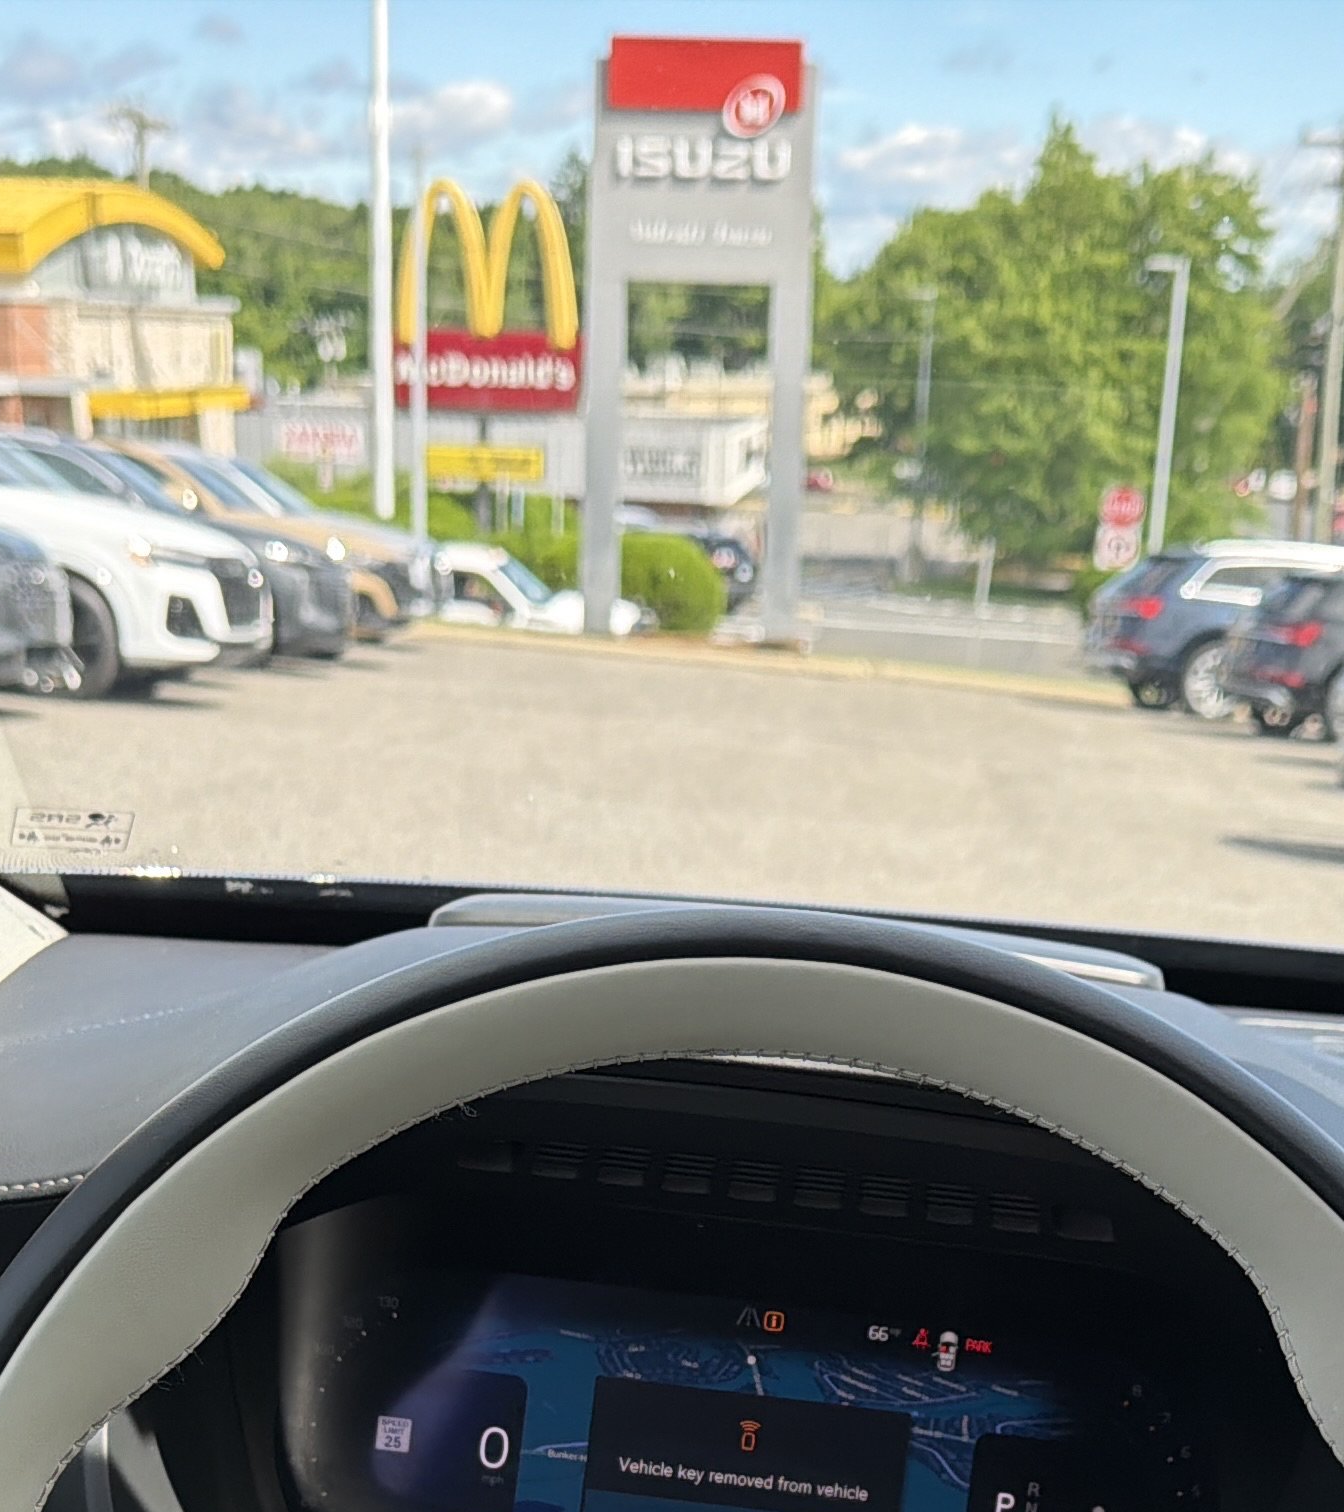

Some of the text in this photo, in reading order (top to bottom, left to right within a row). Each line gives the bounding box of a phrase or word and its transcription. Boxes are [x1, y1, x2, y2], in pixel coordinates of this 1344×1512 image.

[616, 134, 792, 181] ISUZU
[964, 1338, 993, 1354] PARK
[381, 1418, 409, 1428] SPEED
[383, 1427, 405, 1436] LIMIT
[384, 1435, 402, 1449] 25
[479, 1426, 510, 1470] 0
[619, 1456, 869, 1502] Vehicle key removed from vehicle
[1027, 1481, 1041, 1497] R
